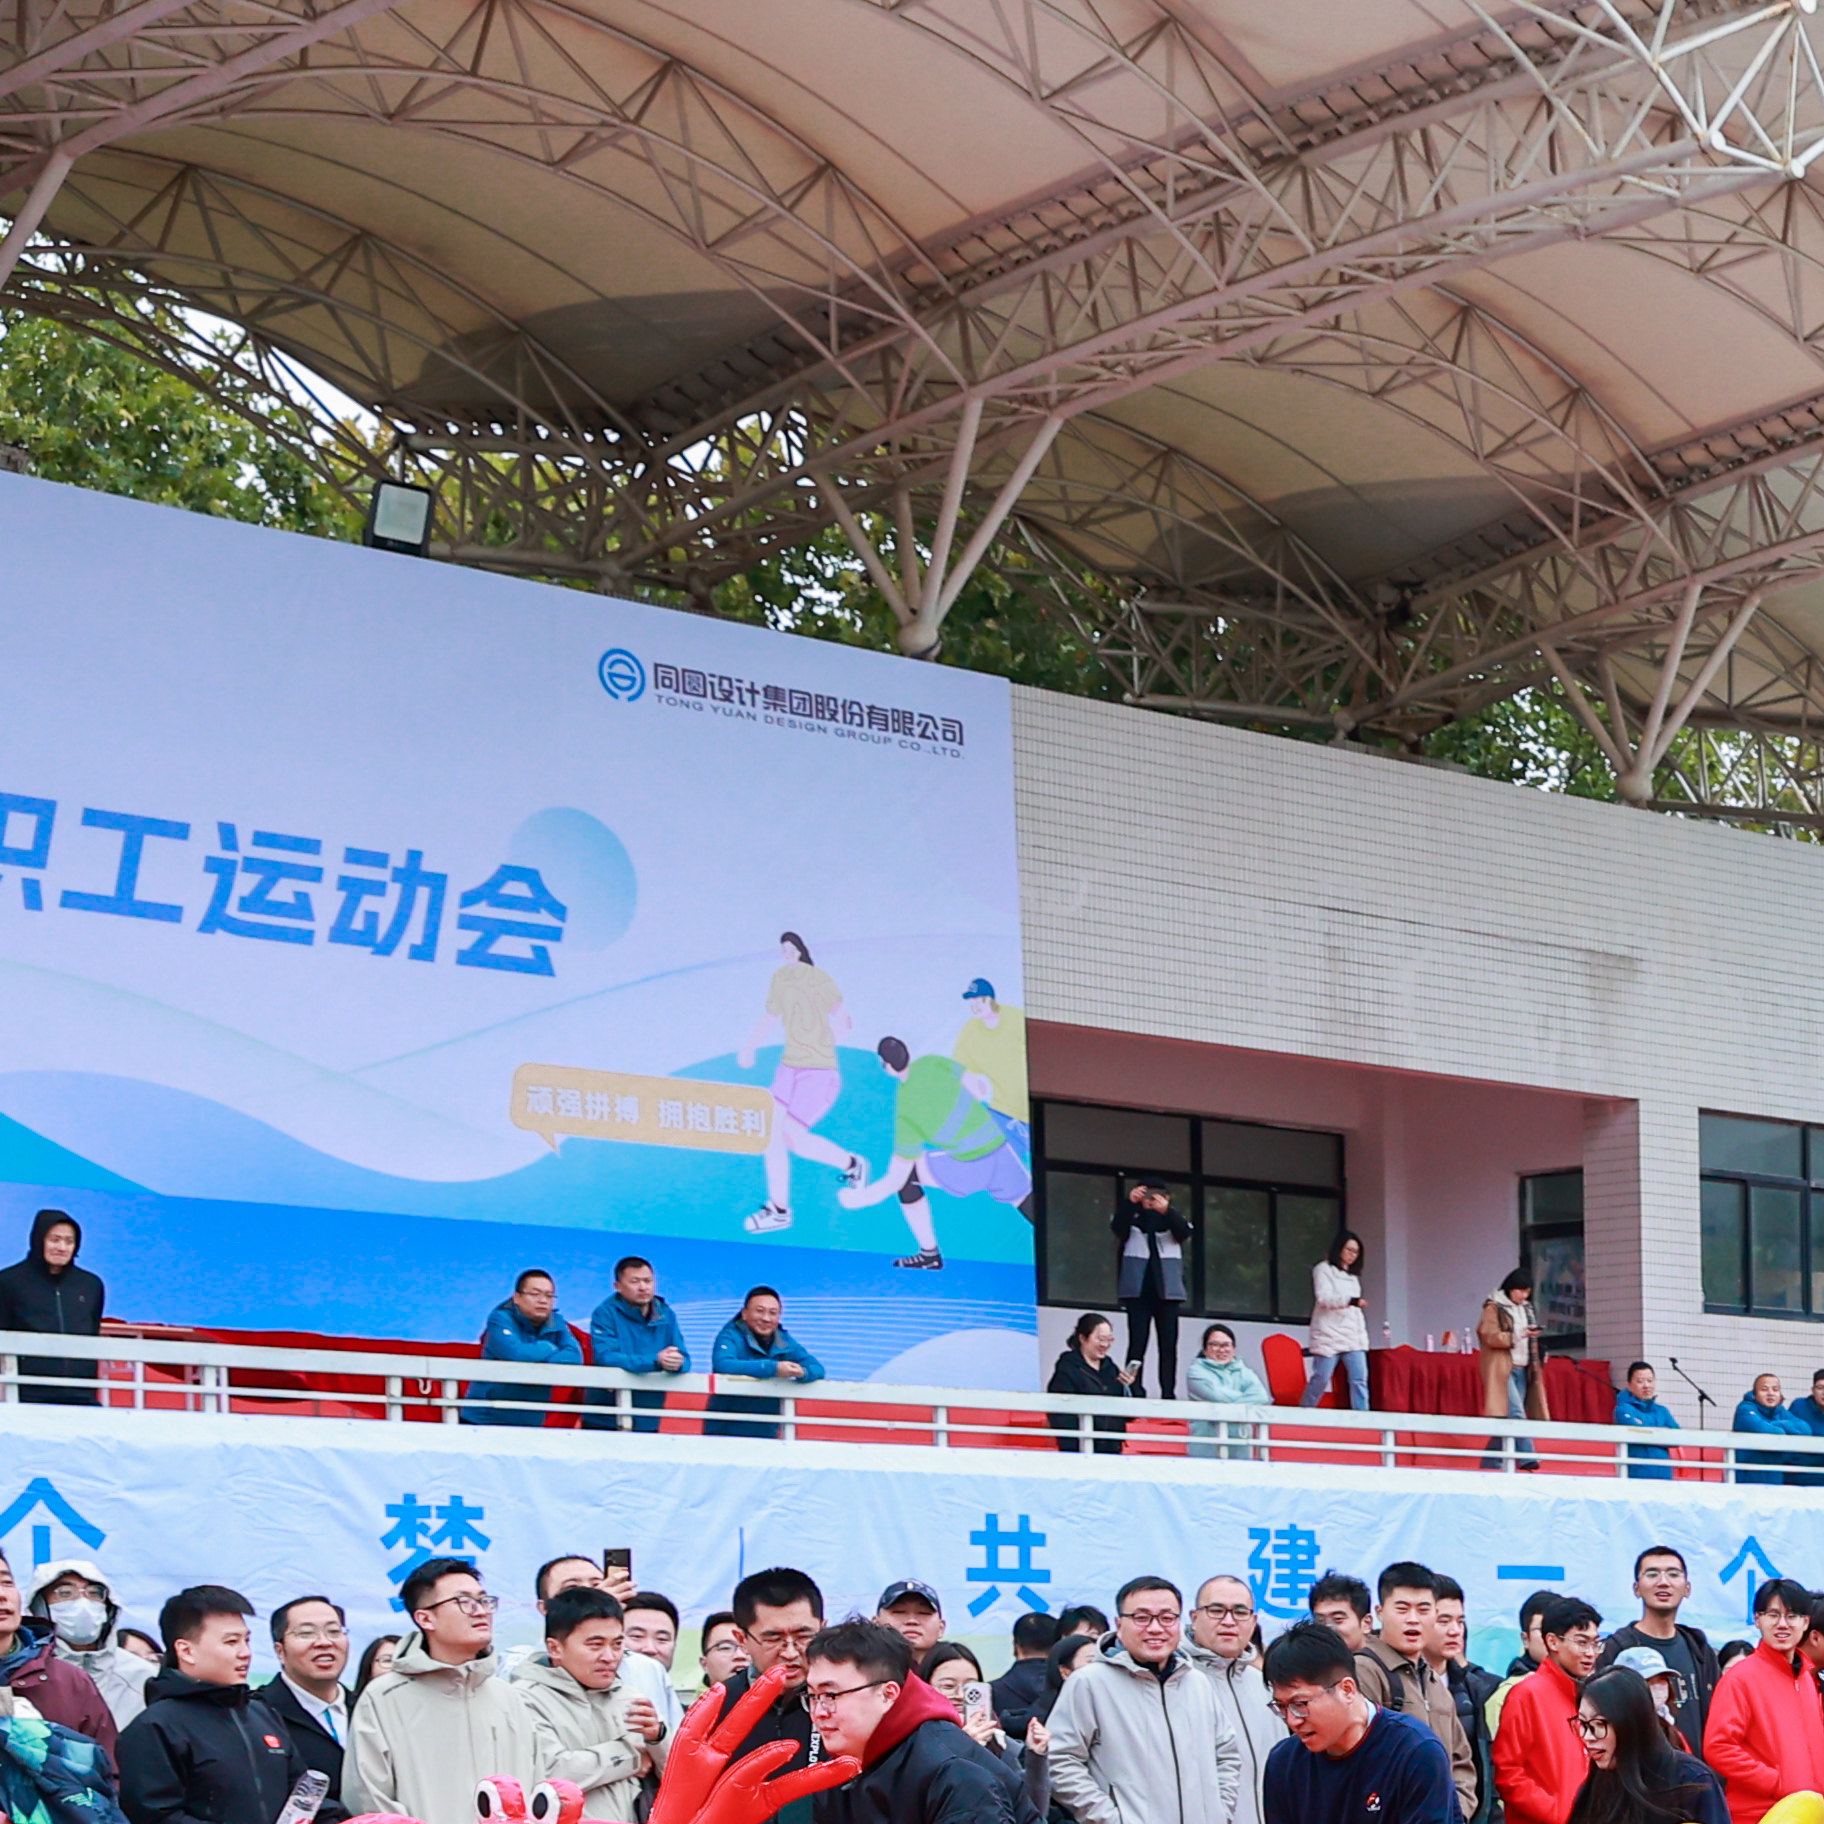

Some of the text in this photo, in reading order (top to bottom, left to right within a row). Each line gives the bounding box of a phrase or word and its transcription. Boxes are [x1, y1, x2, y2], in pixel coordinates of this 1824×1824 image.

[653, 662, 964, 746] 同圆设计集团股份有限公司
[655, 694, 704, 712] TONG
[710, 704, 757, 722] YUAN
[764, 715, 828, 735] DESIGN
[834, 727, 892, 745] GROUP
[526, 1085, 766, 1137] 顽强拼搏 拥抱胜利
